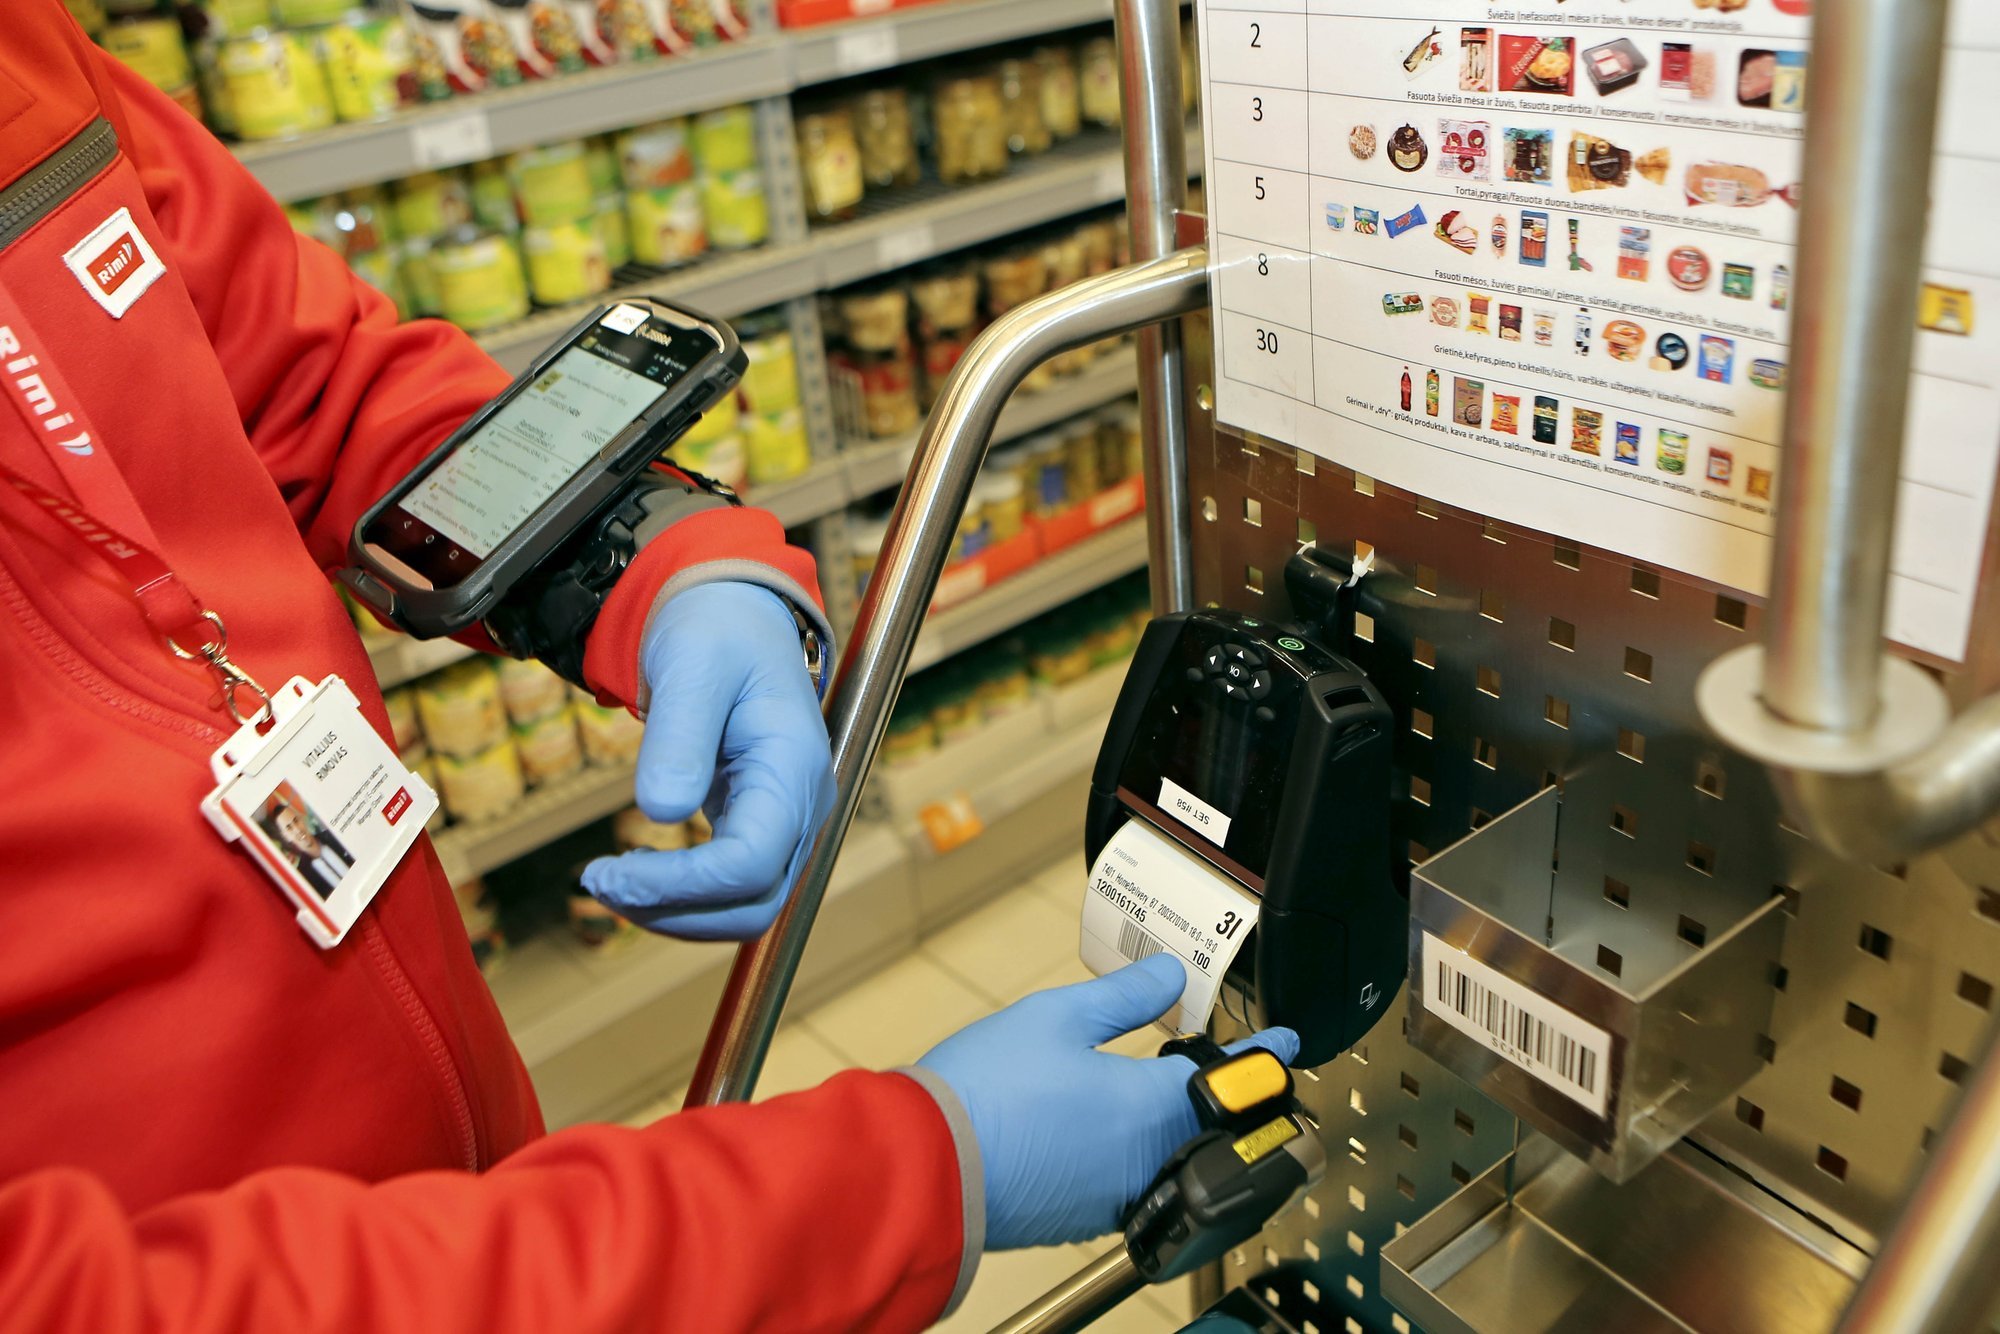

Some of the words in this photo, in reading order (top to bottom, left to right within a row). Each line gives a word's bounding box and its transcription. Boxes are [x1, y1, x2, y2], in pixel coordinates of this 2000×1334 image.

[1250, 23, 1261, 48] 2
[1252, 97, 1263, 122] 3
[1407, 91, 1436, 102] Fasuota
[1437, 92, 1462, 104] šviežia
[1464, 95, 1485, 106] mėsa
[1487, 96, 1493, 106] ir
[1495, 97, 1517, 110] žuvis,
[1519, 99, 1550, 111] fasuota
[1552, 101, 1592, 115] perdirbta
[1255, 176, 1265, 200] 5
[1454, 185, 1542, 205] Tortai,pyragai/fasuota
[97, 250, 128, 286] Rimi
[1258, 253, 1269, 276] 8
[1434, 269, 1461, 282] Fasuoti
[1462, 274, 1489, 287] mėsos,
[1491, 278, 1516, 291] žuvies
[1556, 290, 1586, 304] pienas,
[1256, 328, 1278, 354] 30
[1434, 344, 1516, 370] Grietinė,kefyras,pieno
[0, 325, 75, 432] Rimi
[1346, 396, 1368, 409] Gėrimai
[1394, 411, 1413, 425] grūdų
[1414, 419, 1449, 435] produktai,
[1450, 427, 1467, 438] kava
[1503, 441, 1548, 458] saldumynai
[1229, 664, 1240, 678] OK
[315, 746, 349, 782] RIMOVAS
[1193, 810, 1210, 825] SET
[1096, 878, 1147, 923] 1200161745
[1192, 949, 1211, 970] 100
[1491, 1036, 1534, 1070] SCALE
